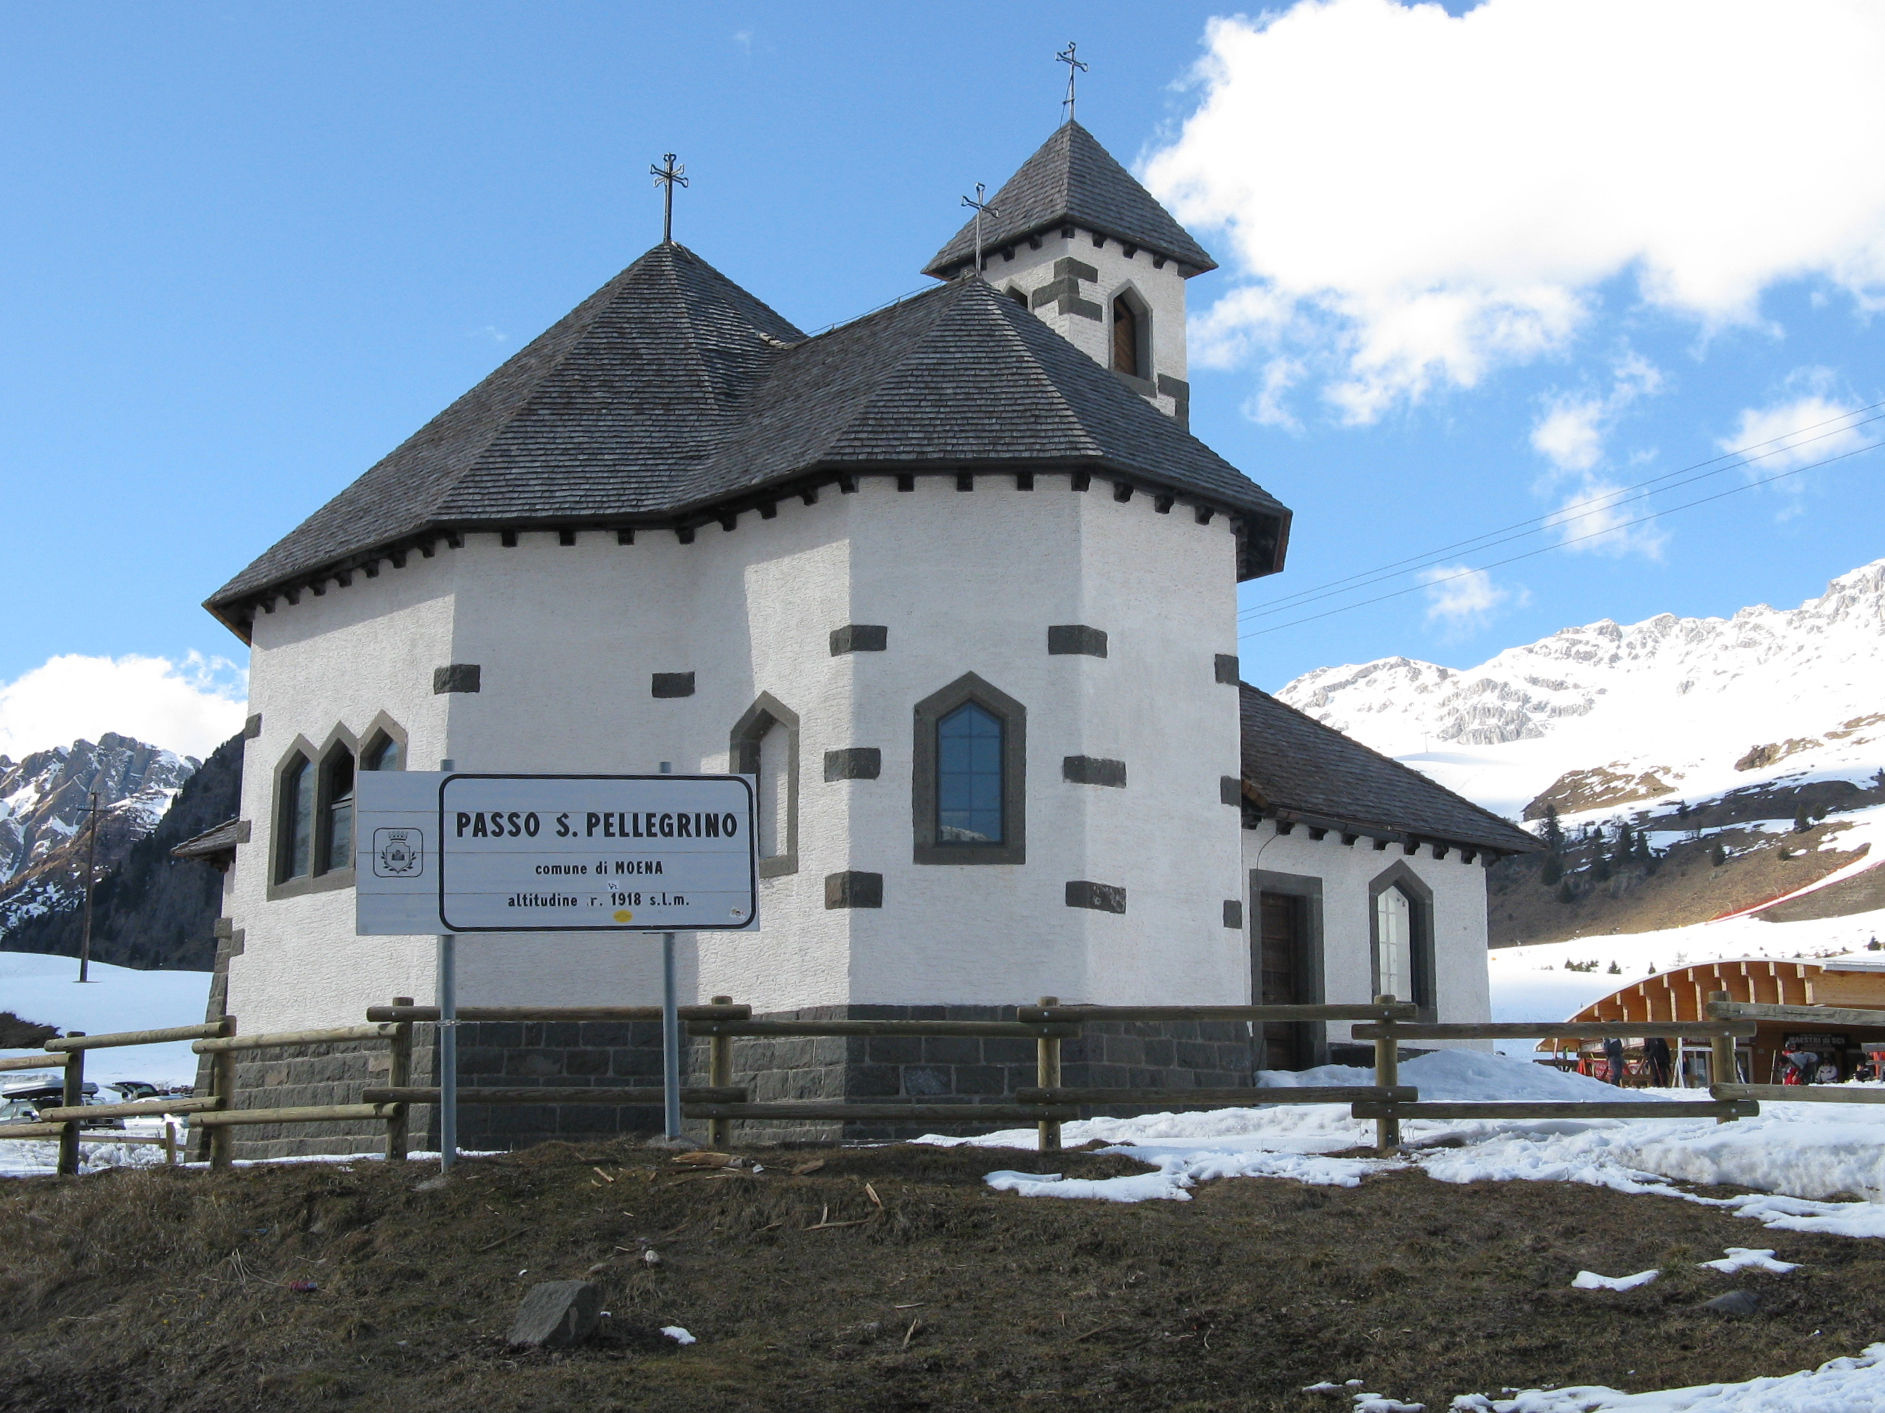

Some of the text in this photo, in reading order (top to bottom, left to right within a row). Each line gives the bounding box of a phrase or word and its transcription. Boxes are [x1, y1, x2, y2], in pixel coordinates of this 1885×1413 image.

[456, 811, 738, 838] PASSO S. PELLEGRINO
[535, 860, 663, 875] comune di MOENA
[507, 892, 578, 908] altitudine
[610, 891, 642, 907] 1918
[649, 891, 690, 907] s.l.m.
